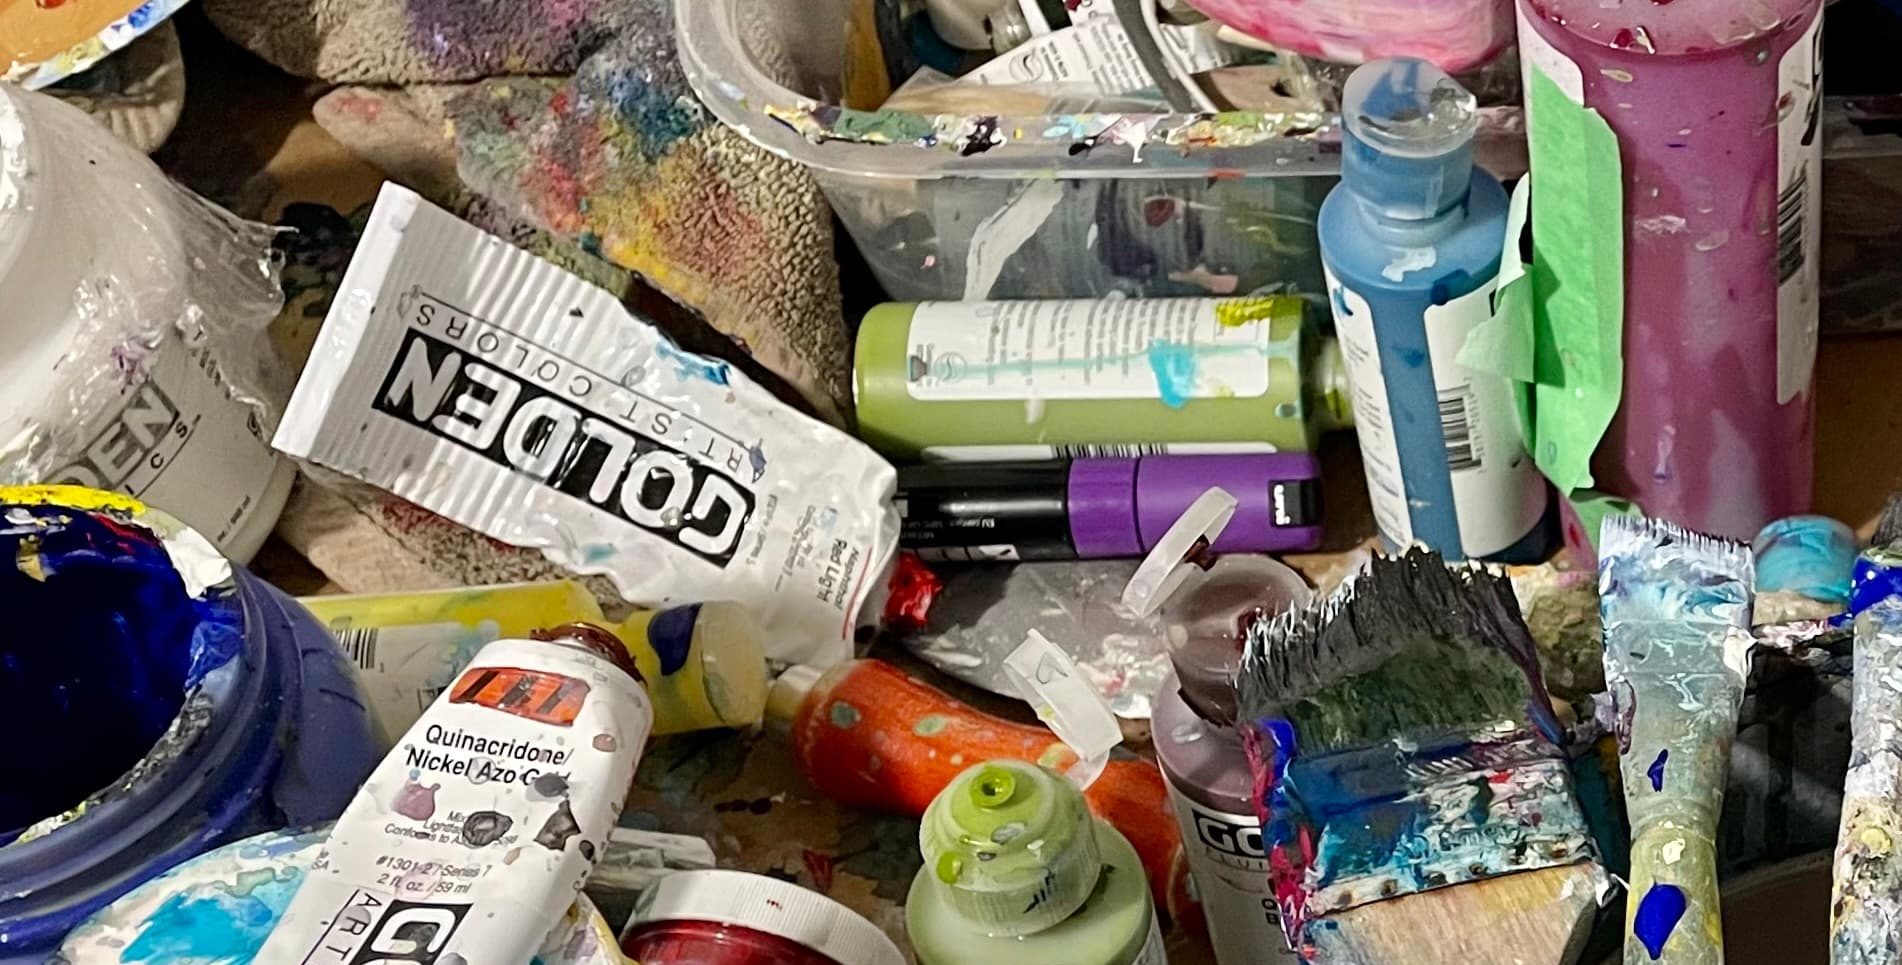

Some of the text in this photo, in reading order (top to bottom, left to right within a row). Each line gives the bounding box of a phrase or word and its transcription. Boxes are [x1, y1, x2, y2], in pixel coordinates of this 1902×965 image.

[416, 303, 768, 485] RTST COLORS
[378, 334, 750, 558] GOLDEN
[816, 537, 848, 603] Red Light
[405, 746, 473, 777] Nickel
[475, 761, 518, 784] Azo
[425, 724, 576, 767] Quinacridone/
[434, 879, 454, 893] 59
[454, 882, 473, 894] ml
